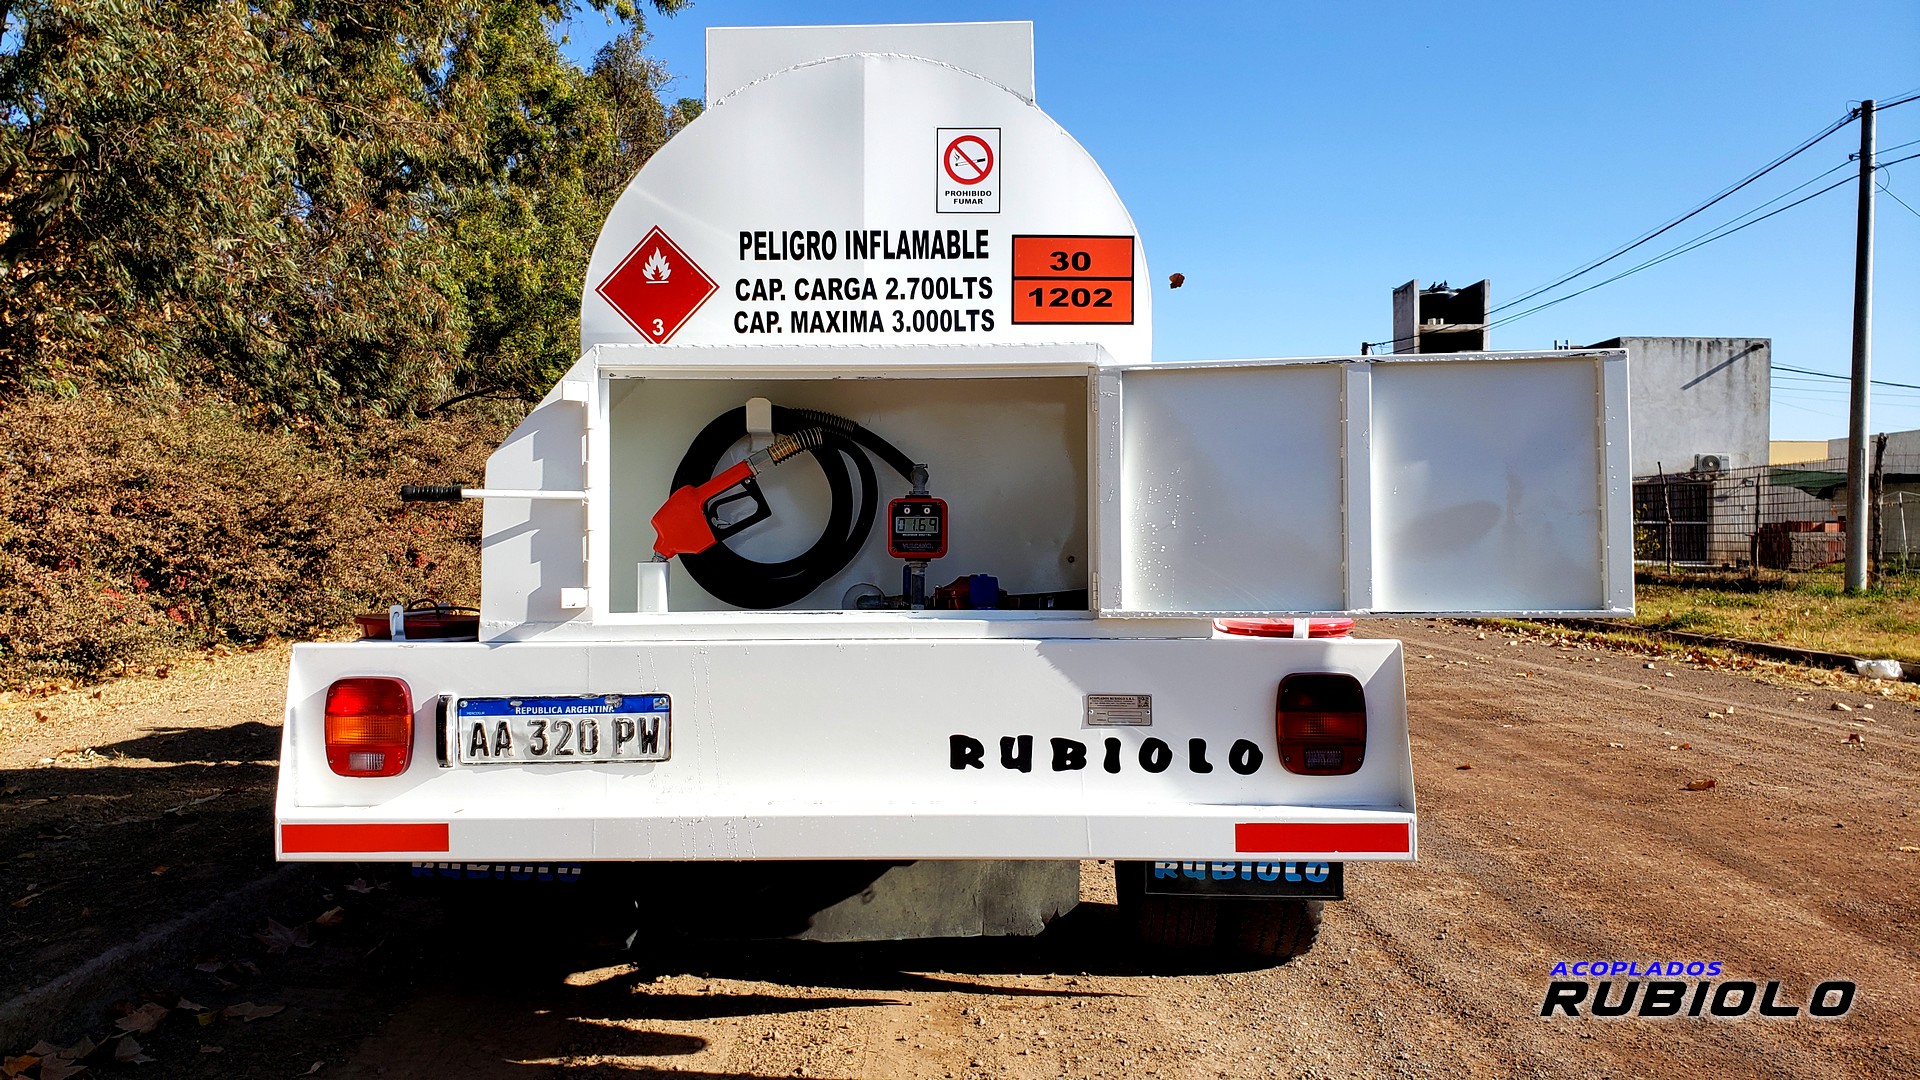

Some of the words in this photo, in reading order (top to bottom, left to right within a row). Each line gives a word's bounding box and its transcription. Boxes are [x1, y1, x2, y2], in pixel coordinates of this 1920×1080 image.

[739, 230, 837, 261] PELIGRO
[845, 229, 989, 260] INFLAMABLE
[1049, 251, 1092, 272] 30
[735, 278, 786, 302] CAP.
[794, 277, 878, 301] CARGA
[885, 276, 993, 300] 2.700LTS
[1028, 287, 1113, 308] 1202
[651, 318, 665, 337] 3
[733, 310, 782, 334] CAP.
[790, 310, 885, 334] MAXIMA
[892, 308, 995, 333] 3.000LTS
[515, 706, 563, 714] REPUBLICA
[469, 719, 514, 757] AA
[527, 718, 599, 756] 320
[615, 716, 661, 754] PW
[949, 734, 1264, 776] RUBIOLO
[1154, 861, 1330, 883] RUBIOLO
